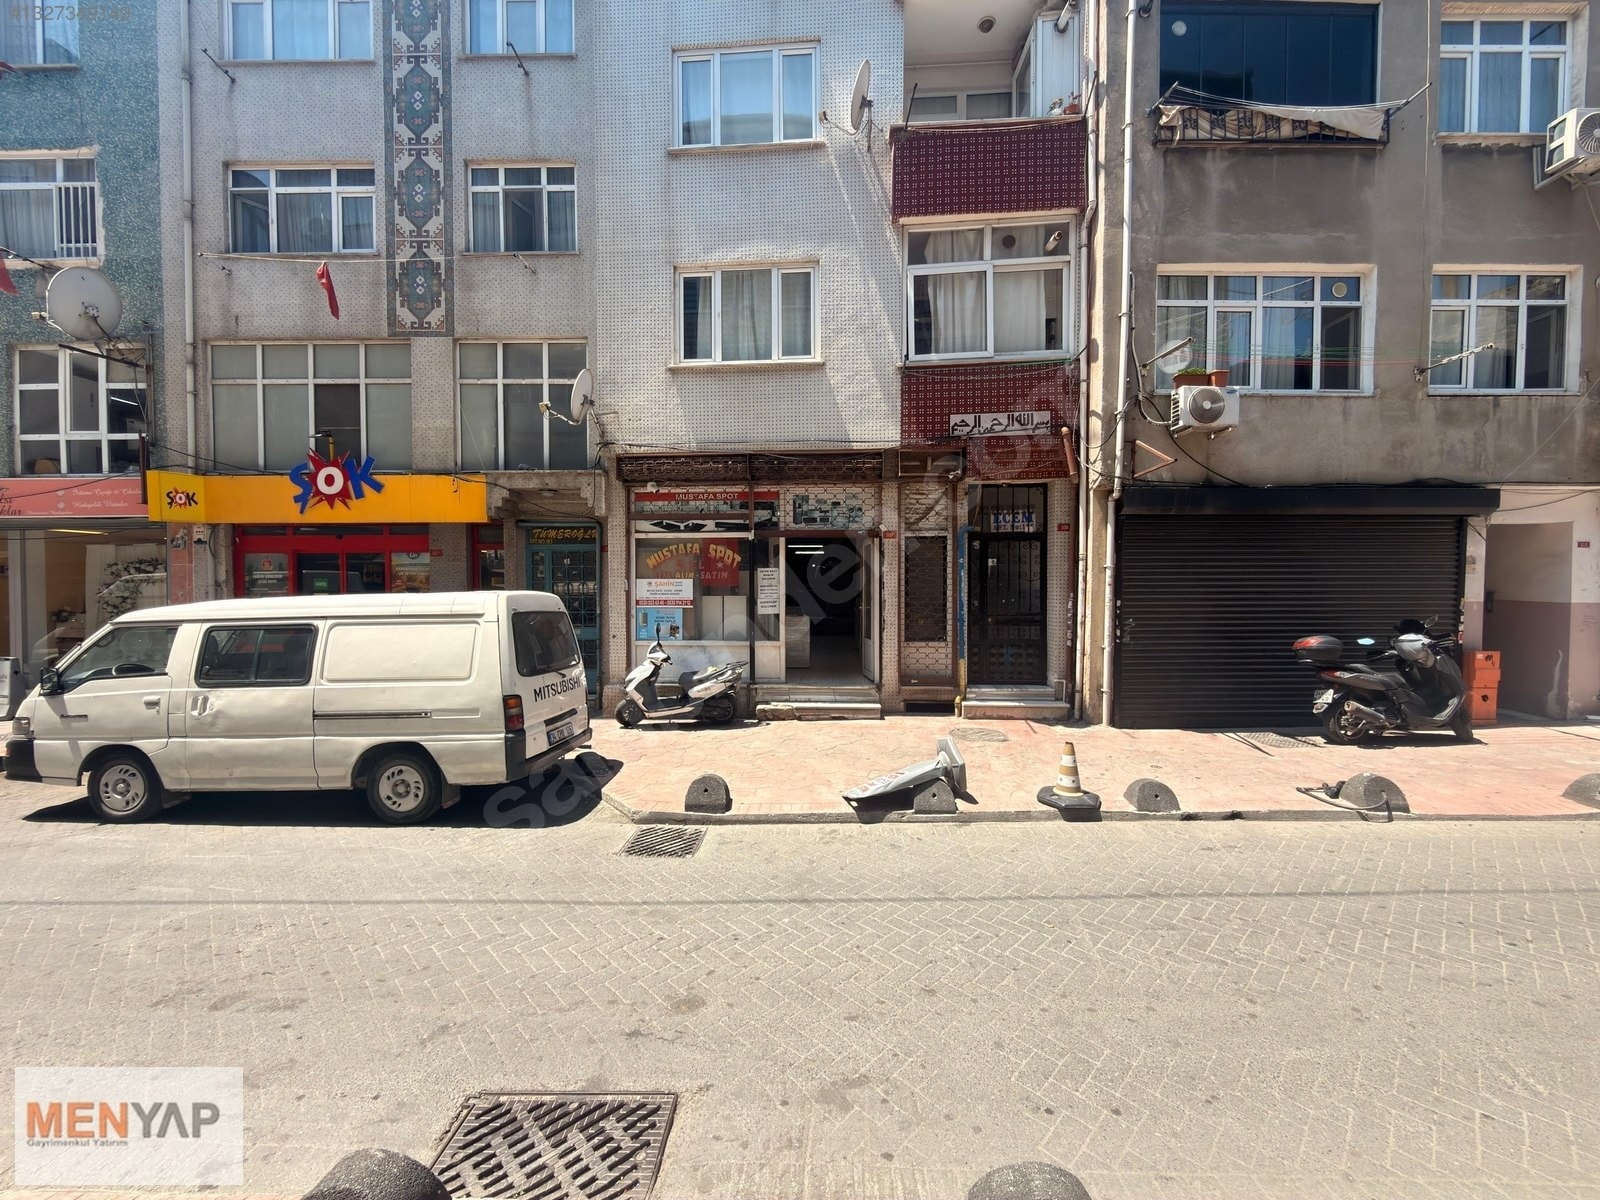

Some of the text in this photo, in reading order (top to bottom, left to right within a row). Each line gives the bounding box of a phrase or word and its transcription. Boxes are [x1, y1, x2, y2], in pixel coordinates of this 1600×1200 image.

[289, 455, 385, 515] ŞOK
[166, 490, 198, 509] ŞOK
[992, 510, 1034, 524] ECEM
[646, 543, 701, 569] MUSTAFA
[708, 543, 742, 569] SPOT
[700, 571, 728, 579] SATIM
[533, 675, 581, 702] MITSUBISHI
